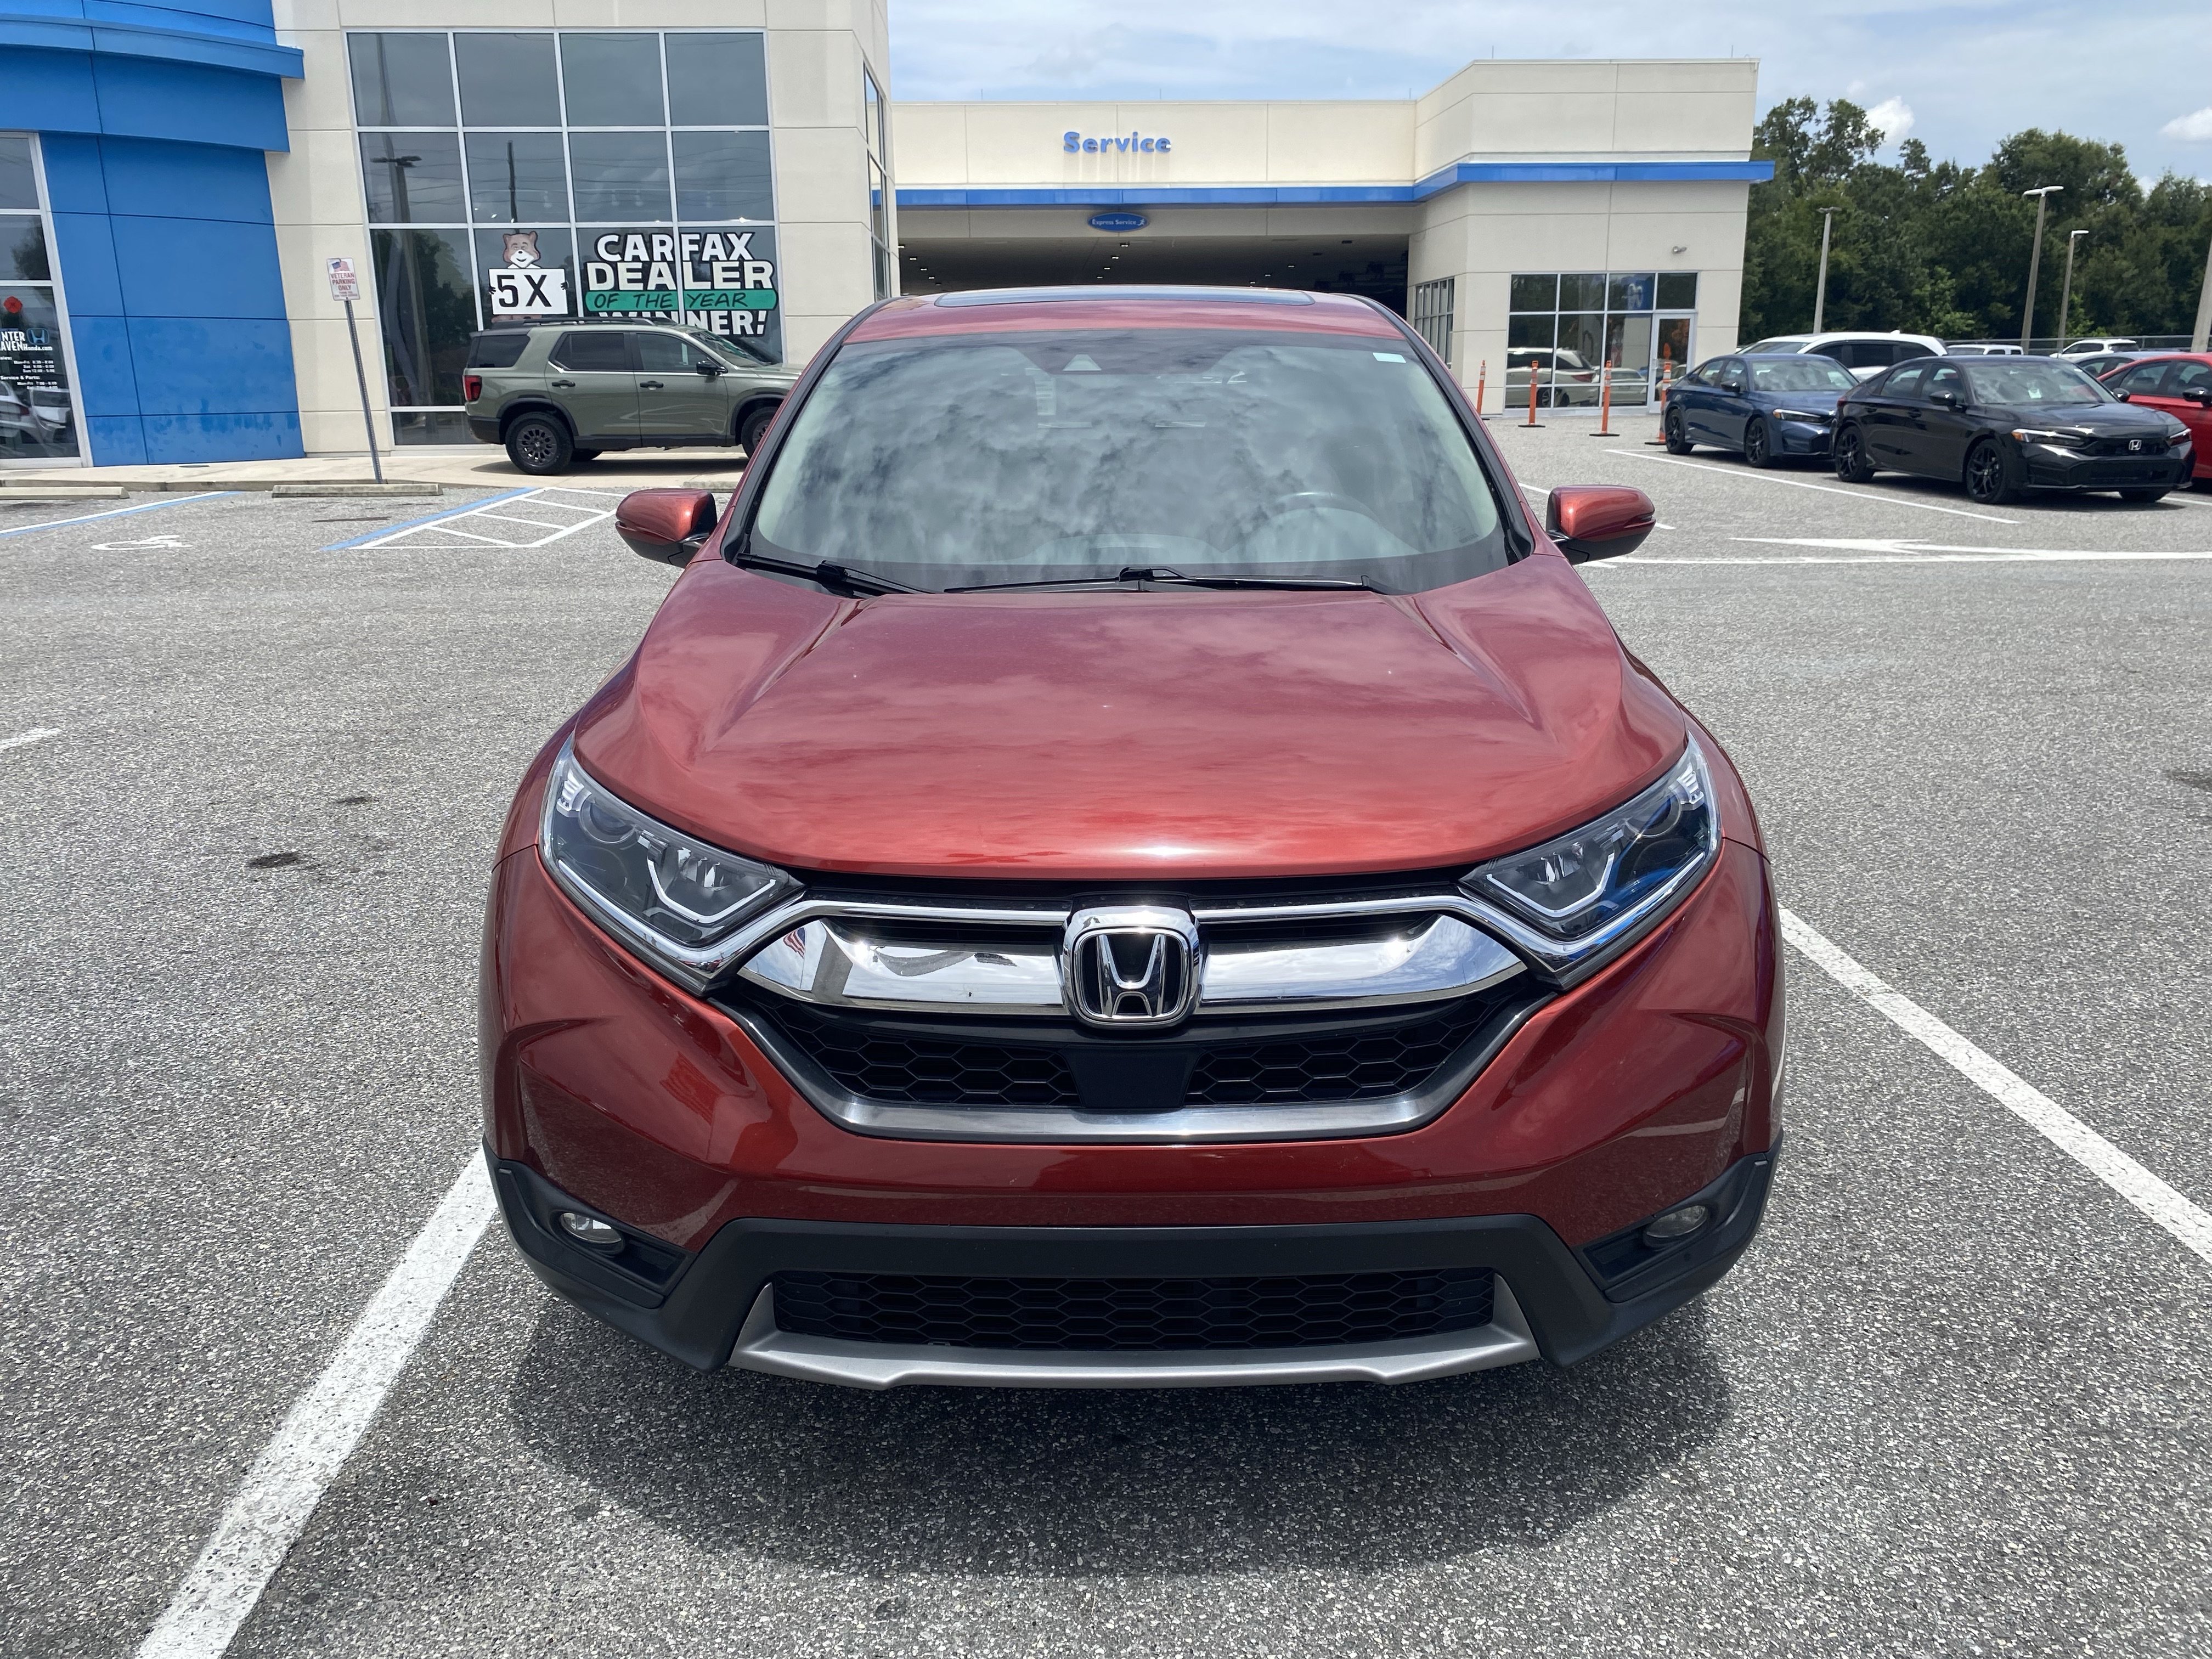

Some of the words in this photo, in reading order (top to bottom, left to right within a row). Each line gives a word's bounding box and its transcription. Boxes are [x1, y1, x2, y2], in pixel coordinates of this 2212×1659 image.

[1064, 131, 1171, 154] Service
[597, 233, 753, 262] CARFAX
[586, 261, 773, 291] DEALER
[594, 292, 620, 309] OF
[633, 294, 674, 309] THE
[685, 292, 748, 308] YEAR
[0, 340, 22, 351] AVEN
